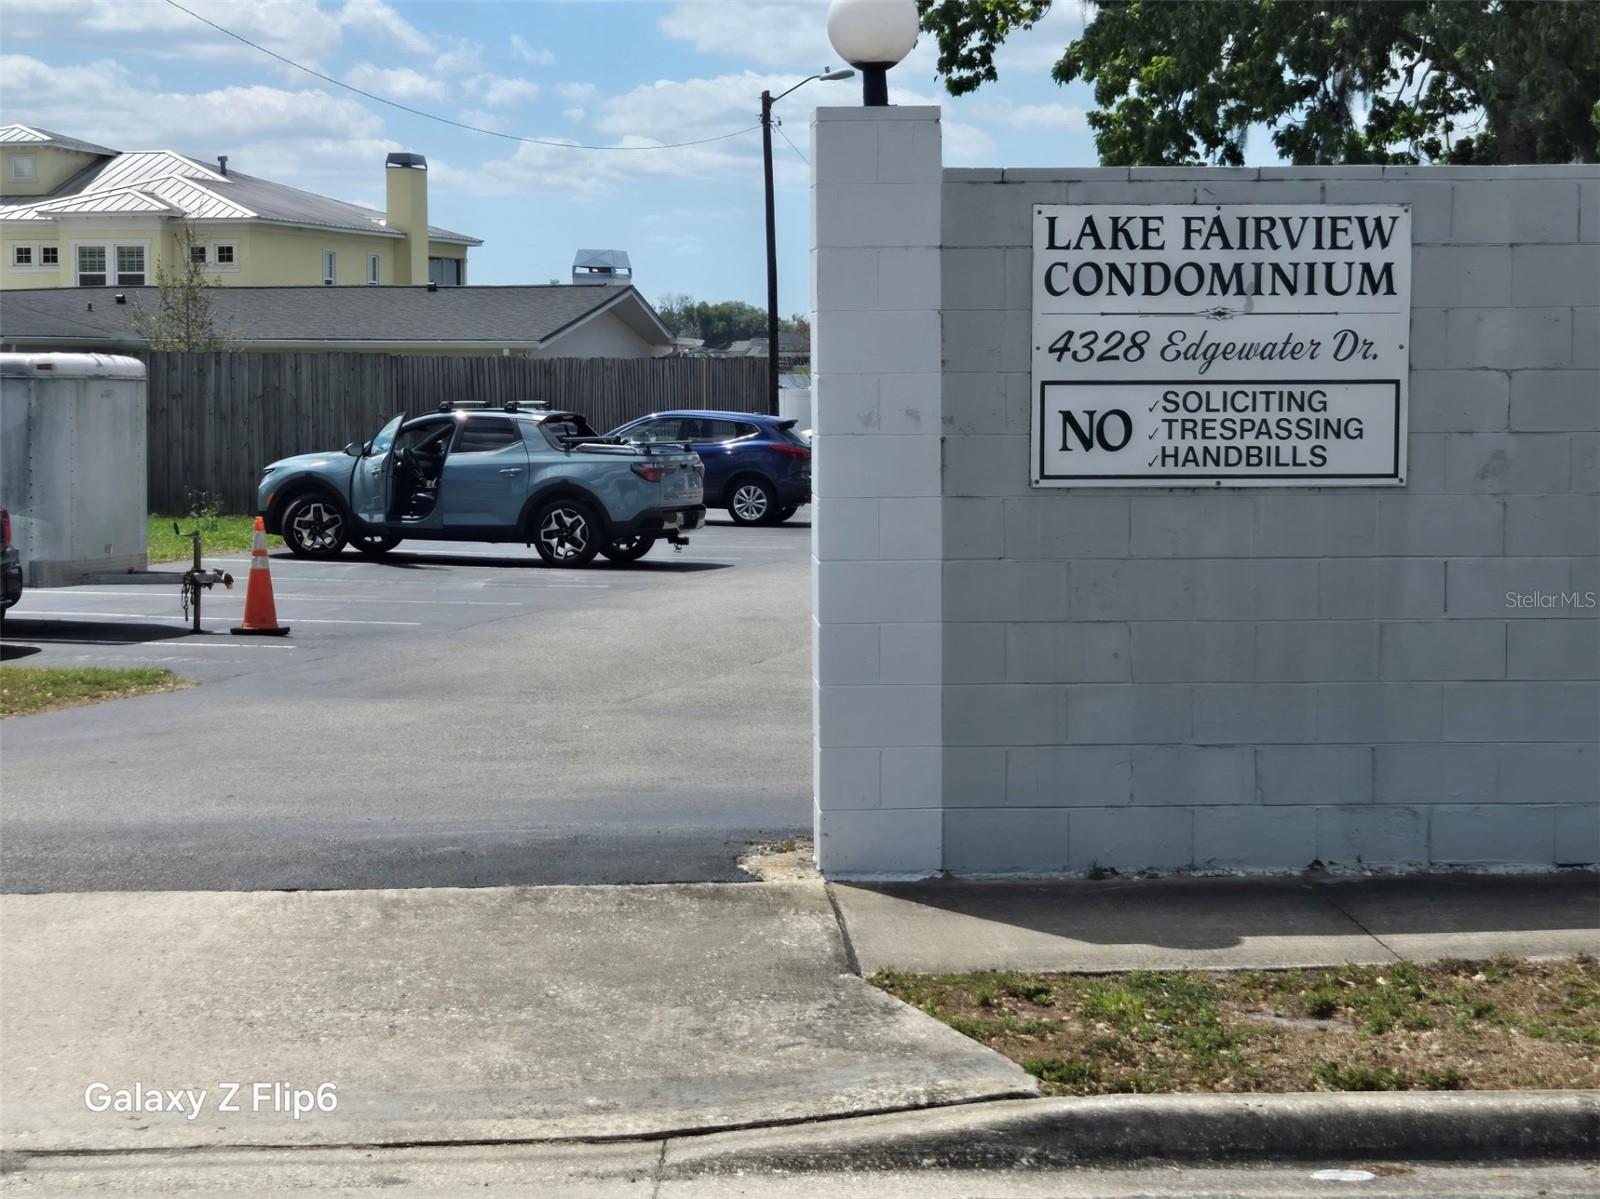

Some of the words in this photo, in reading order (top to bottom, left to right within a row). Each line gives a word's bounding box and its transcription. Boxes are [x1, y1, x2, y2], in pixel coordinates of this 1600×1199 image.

[1044, 214, 1166, 251] LAKE
[1181, 214, 1400, 251] FAIRVIEW
[1043, 261, 1398, 297] CONDOMINIUM
[1047, 329, 1151, 363] 4328
[1160, 329, 1322, 375] Edgewater
[1332, 328, 1379, 362] Dr.
[1161, 389, 1328, 414] SOLICITING
[1058, 408, 1134, 453] NO
[1161, 417, 1364, 441] TRESPASSING
[1159, 445, 1328, 468] HANDBILLS
